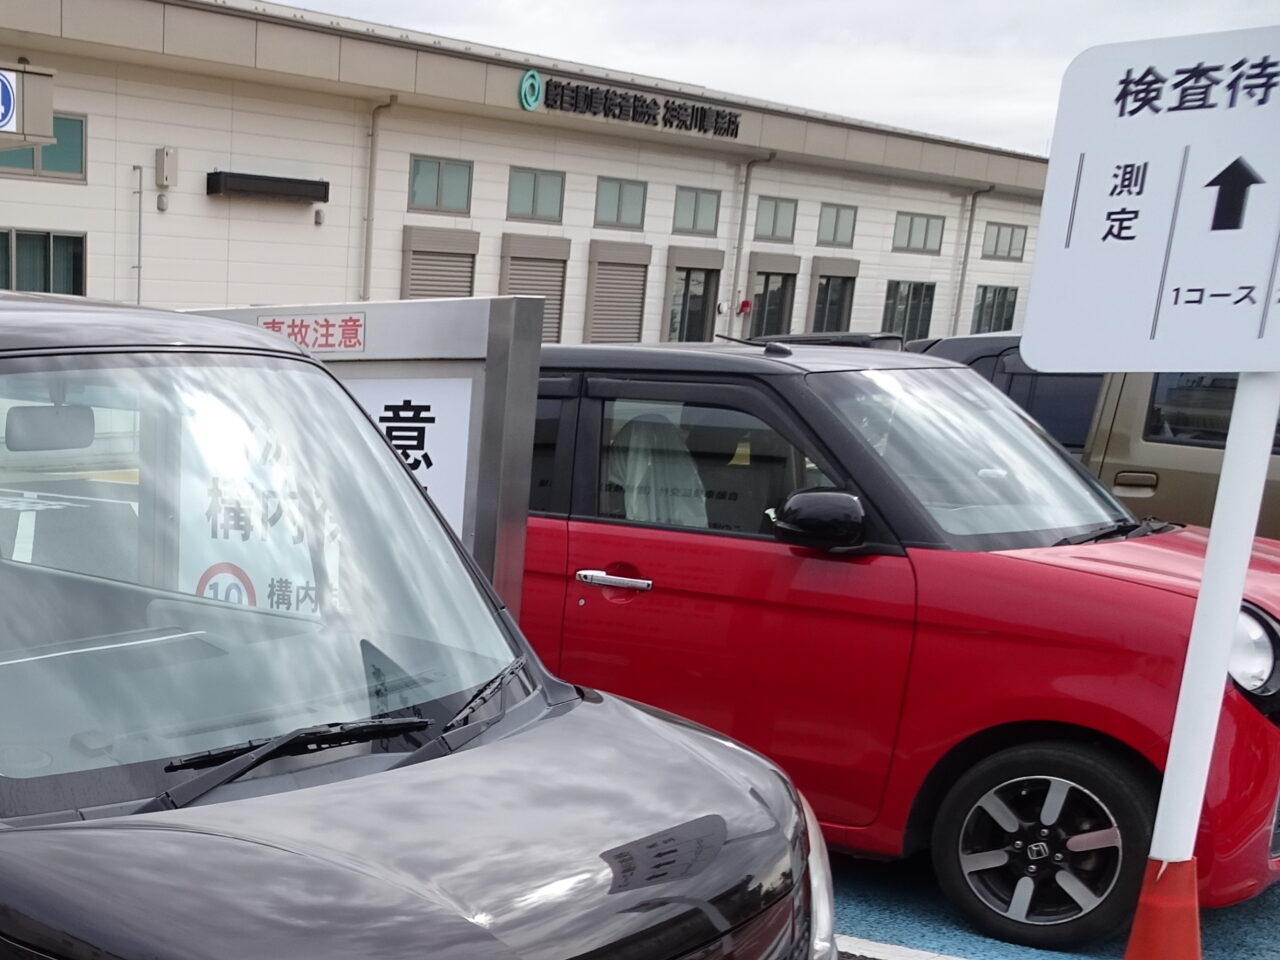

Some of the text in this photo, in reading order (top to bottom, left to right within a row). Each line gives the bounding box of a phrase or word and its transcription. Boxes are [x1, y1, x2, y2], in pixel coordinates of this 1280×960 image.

[1101, 161, 1149, 242] 測定
[1171, 285, 1257, 306] 1コース
